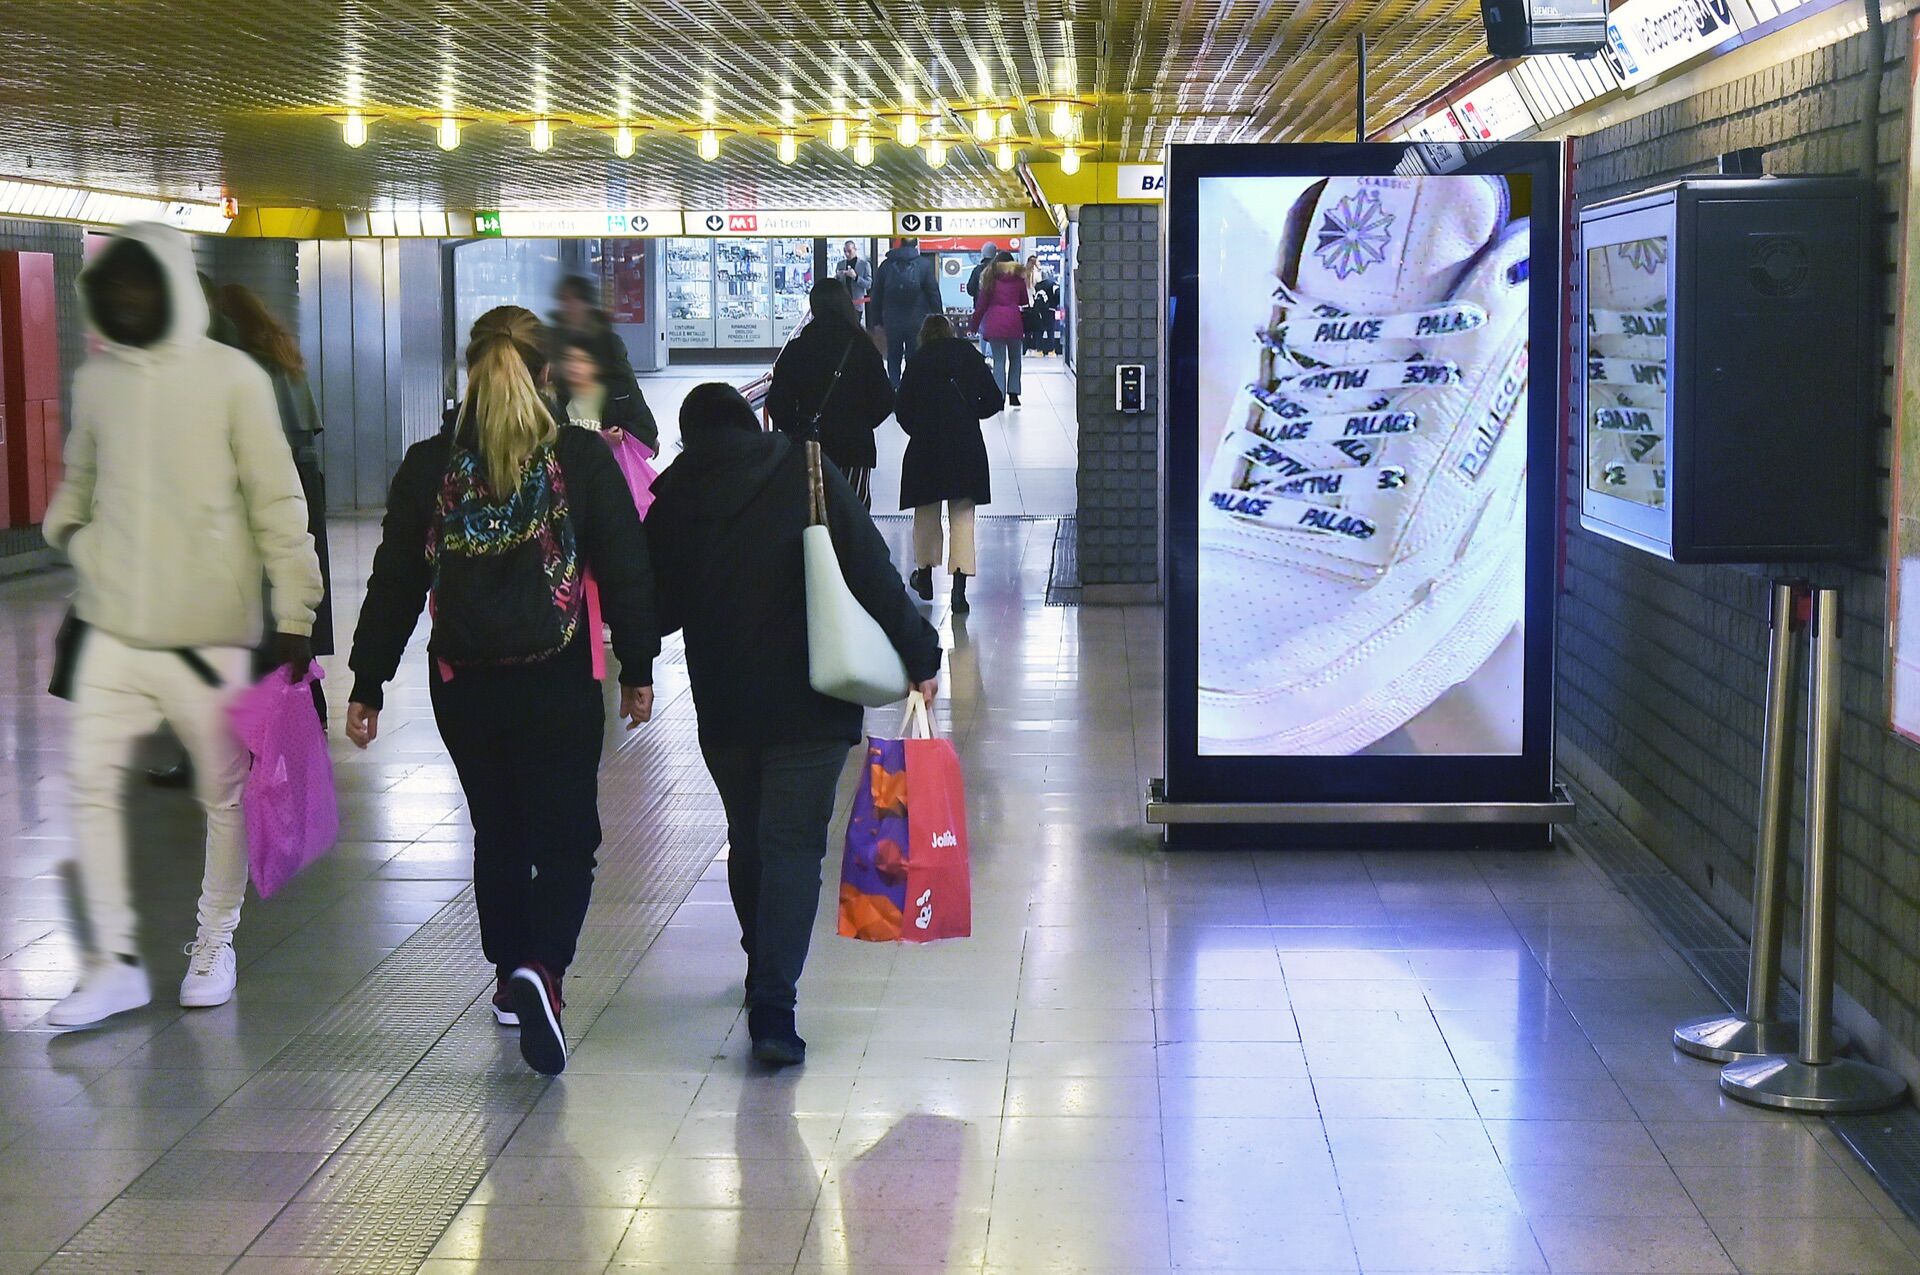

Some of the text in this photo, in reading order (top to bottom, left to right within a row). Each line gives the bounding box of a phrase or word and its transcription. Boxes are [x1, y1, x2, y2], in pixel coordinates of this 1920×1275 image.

[1533, 6, 1559, 16] SIEMENS
[1644, 5, 1694, 49] Gonzaga
[1142, 175, 1164, 190] BA
[729, 215, 757, 231] M1
[949, 217, 1020, 229] ATM POINT
[1314, 320, 1383, 342] PALACE
